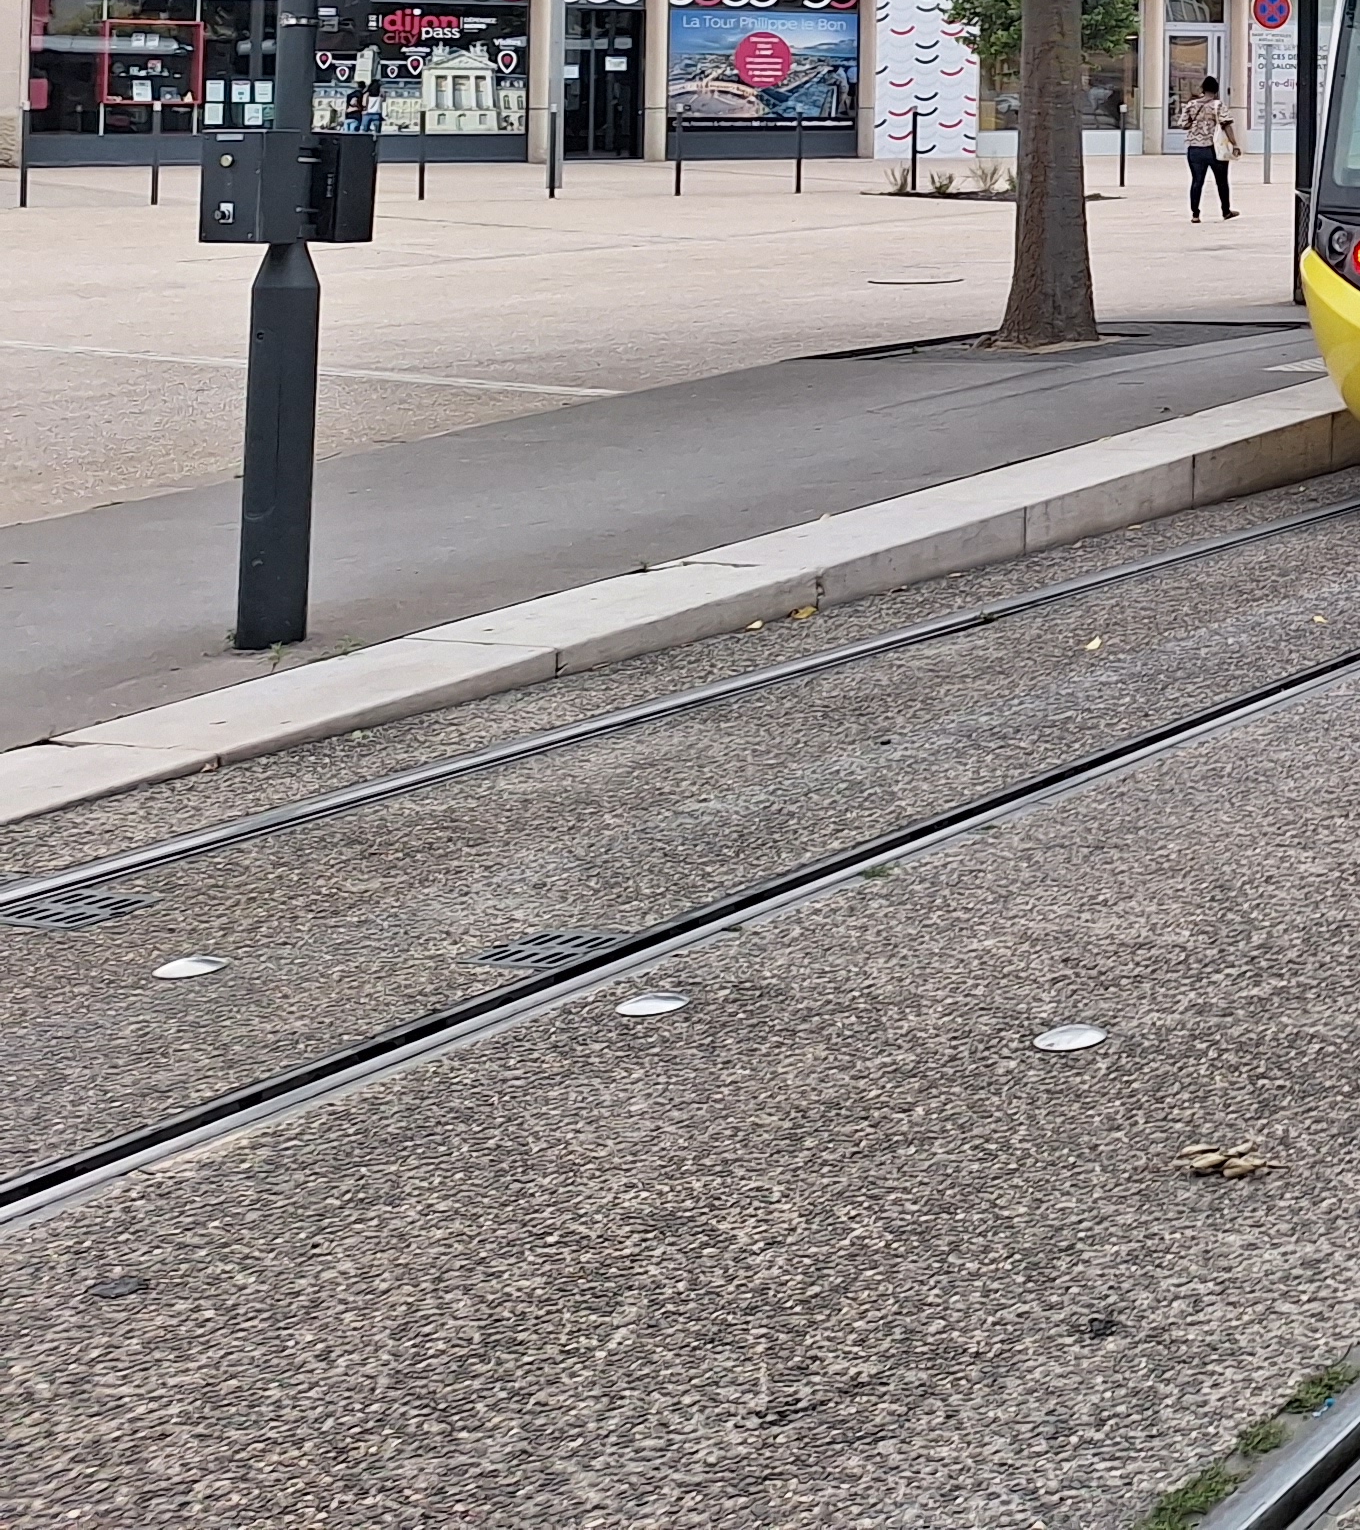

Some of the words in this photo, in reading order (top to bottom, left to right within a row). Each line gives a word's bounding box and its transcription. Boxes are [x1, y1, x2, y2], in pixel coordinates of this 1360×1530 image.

[383, 8, 461, 35] dijon
[682, 15, 700, 28] La
[703, 15, 737, 29] Tour
[739, 16, 798, 33] Philippe
[801, 18, 815, 31] le
[817, 18, 847, 31] Bon
[382, 30, 419, 46] city
[421, 27, 461, 40] pass
